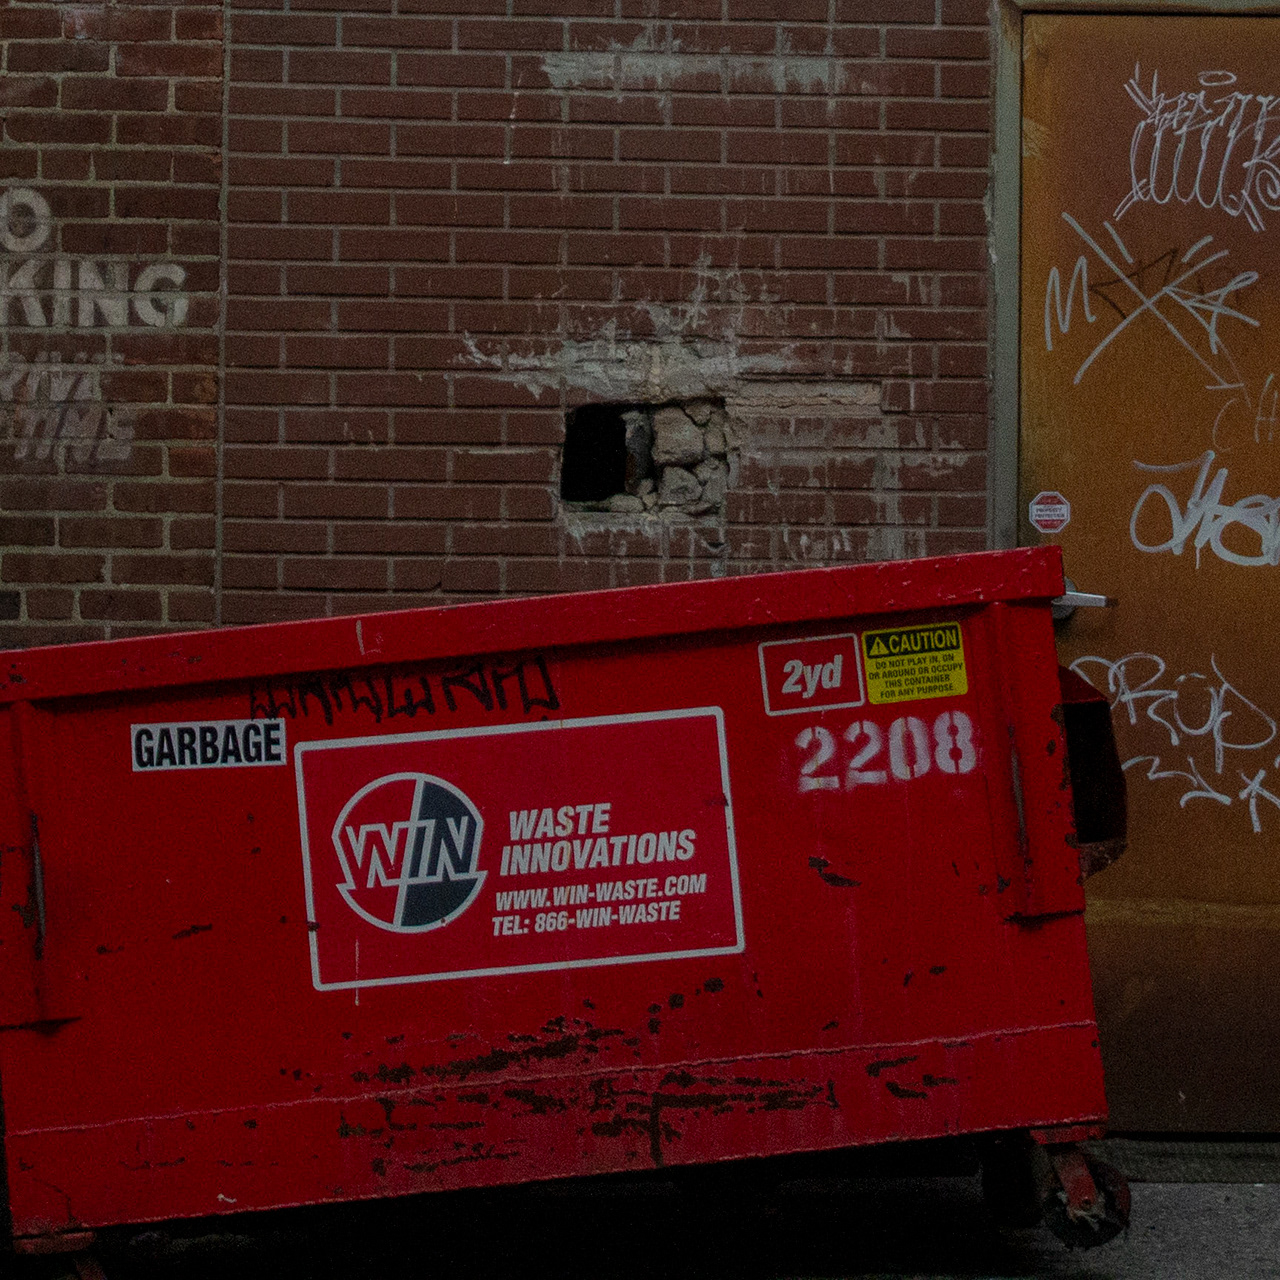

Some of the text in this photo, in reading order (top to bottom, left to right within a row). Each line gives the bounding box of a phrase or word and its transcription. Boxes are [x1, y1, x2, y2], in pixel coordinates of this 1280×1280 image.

[888, 629, 958, 654] CAUTION
[781, 654, 844, 699] 2yd
[875, 661, 887, 670] DO
[888, 658, 906, 669] NOT
[907, 656, 928, 667] PLAY
[882, 667, 916, 679] AROUND
[931, 662, 963, 674] OCCUPY
[885, 673, 951, 689] THIS CONTAINER
[881, 682, 954, 699] FOR ANY PURPOSE
[133, 722, 282, 768] GARBAGE
[793, 709, 977, 793] 2208
[509, 801, 612, 842] WASTE
[499, 828, 697, 877] INNOVATIONS
[495, 872, 708, 912] WWW.WIN-WASTE.COM
[492, 899, 682, 937] TEL: 866-WIN-WASTE
